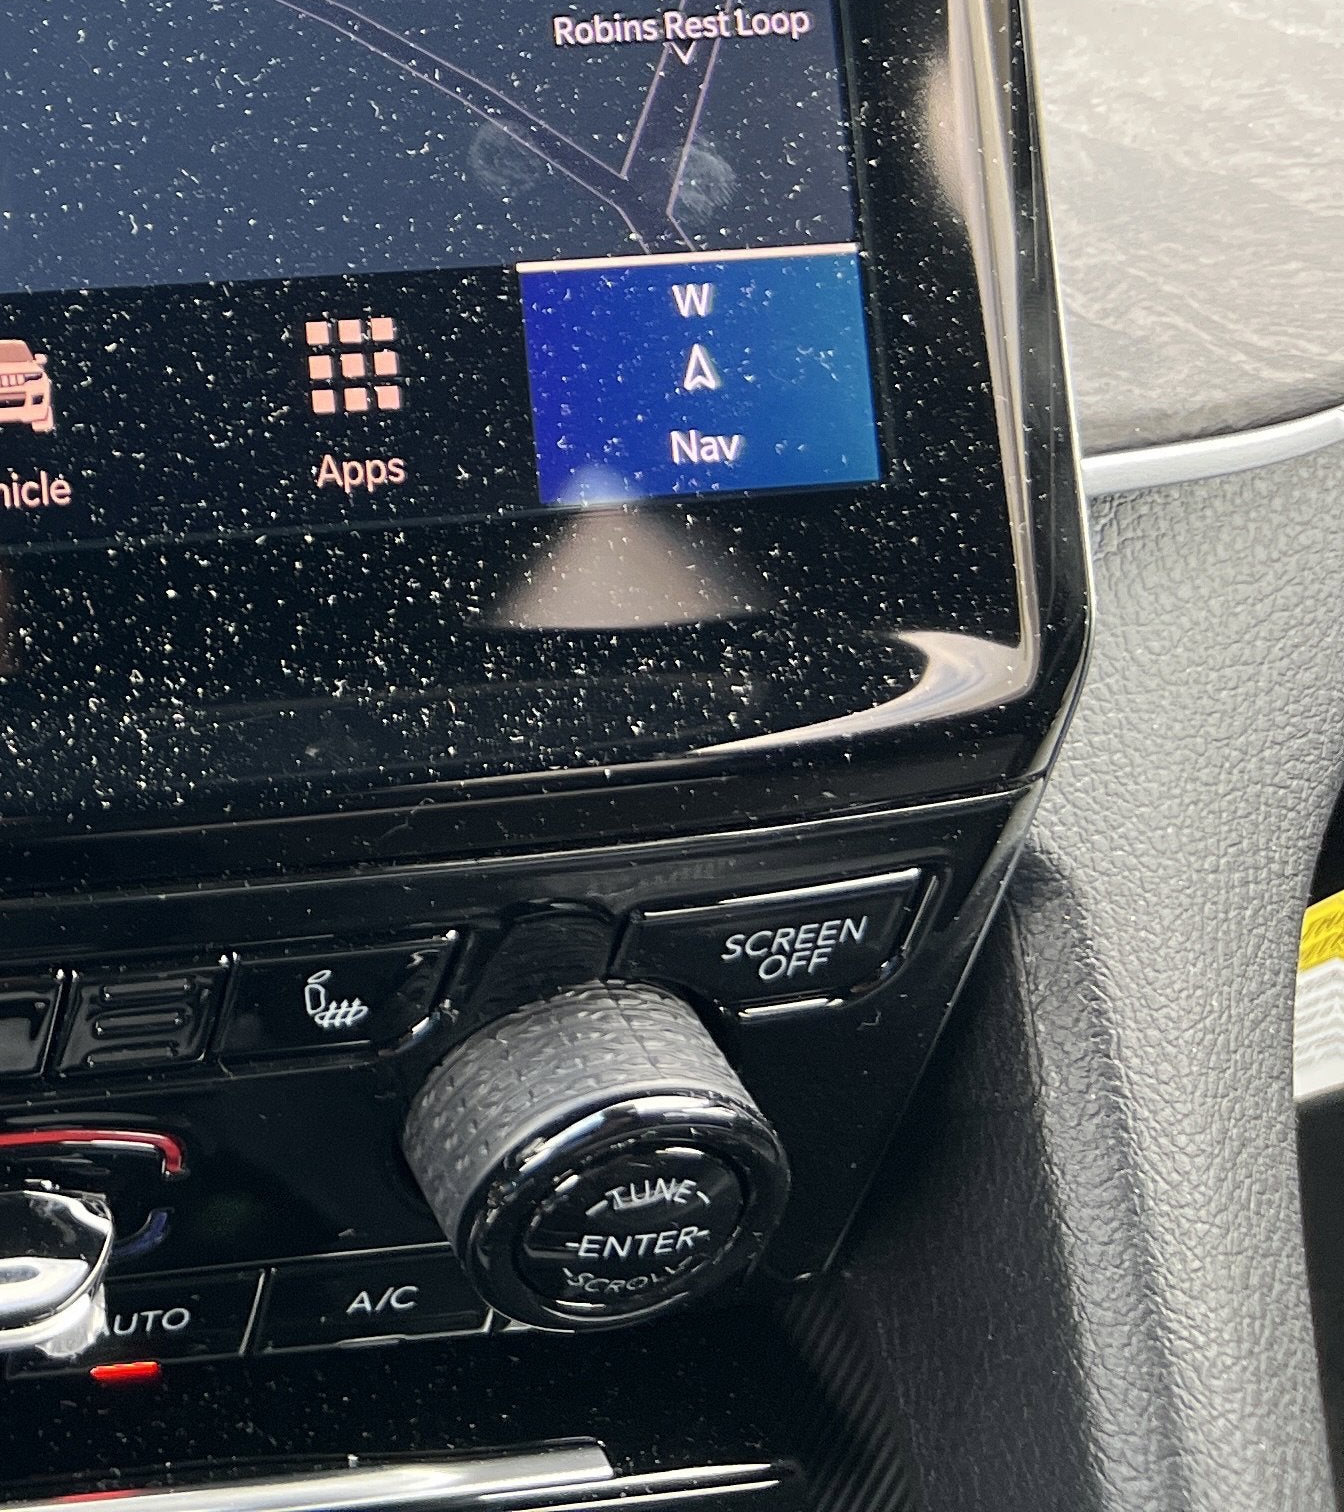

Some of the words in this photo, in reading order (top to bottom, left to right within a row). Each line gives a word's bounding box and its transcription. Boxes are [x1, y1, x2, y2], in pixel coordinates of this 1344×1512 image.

[554, 13, 658, 47] Robins
[666, 9, 728, 40] Rest
[735, 3, 810, 40] Loop
[672, 284, 713, 316] W
[670, 429, 742, 463] Nav
[316, 451, 406, 492] Apps
[721, 915, 868, 963] SCREEN
[757, 945, 834, 981] OFF
[605, 1177, 697, 1208] TUNE
[577, 1226, 700, 1259] ENTER
[345, 1285, 420, 1316] A/C
